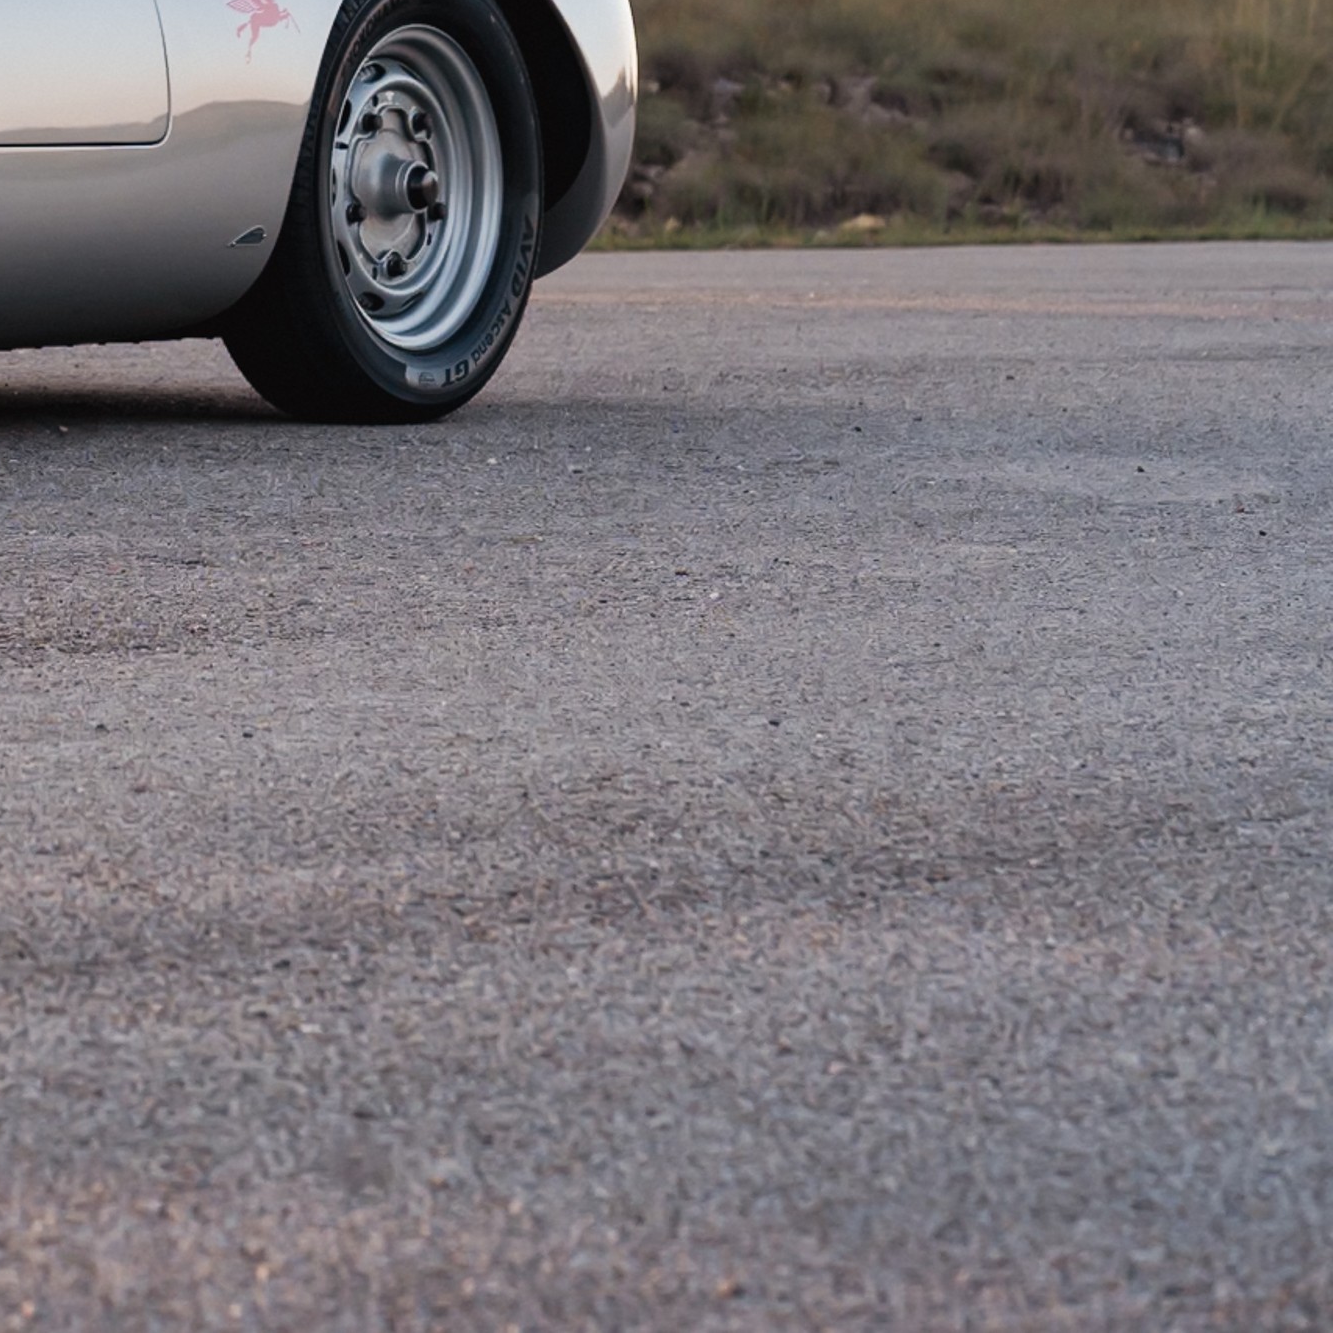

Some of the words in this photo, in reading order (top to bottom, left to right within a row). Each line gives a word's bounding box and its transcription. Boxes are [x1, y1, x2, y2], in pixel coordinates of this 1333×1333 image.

[510, 215, 534, 299] AVID
[471, 300, 512, 366] Ascend
[441, 358, 471, 388] GT
